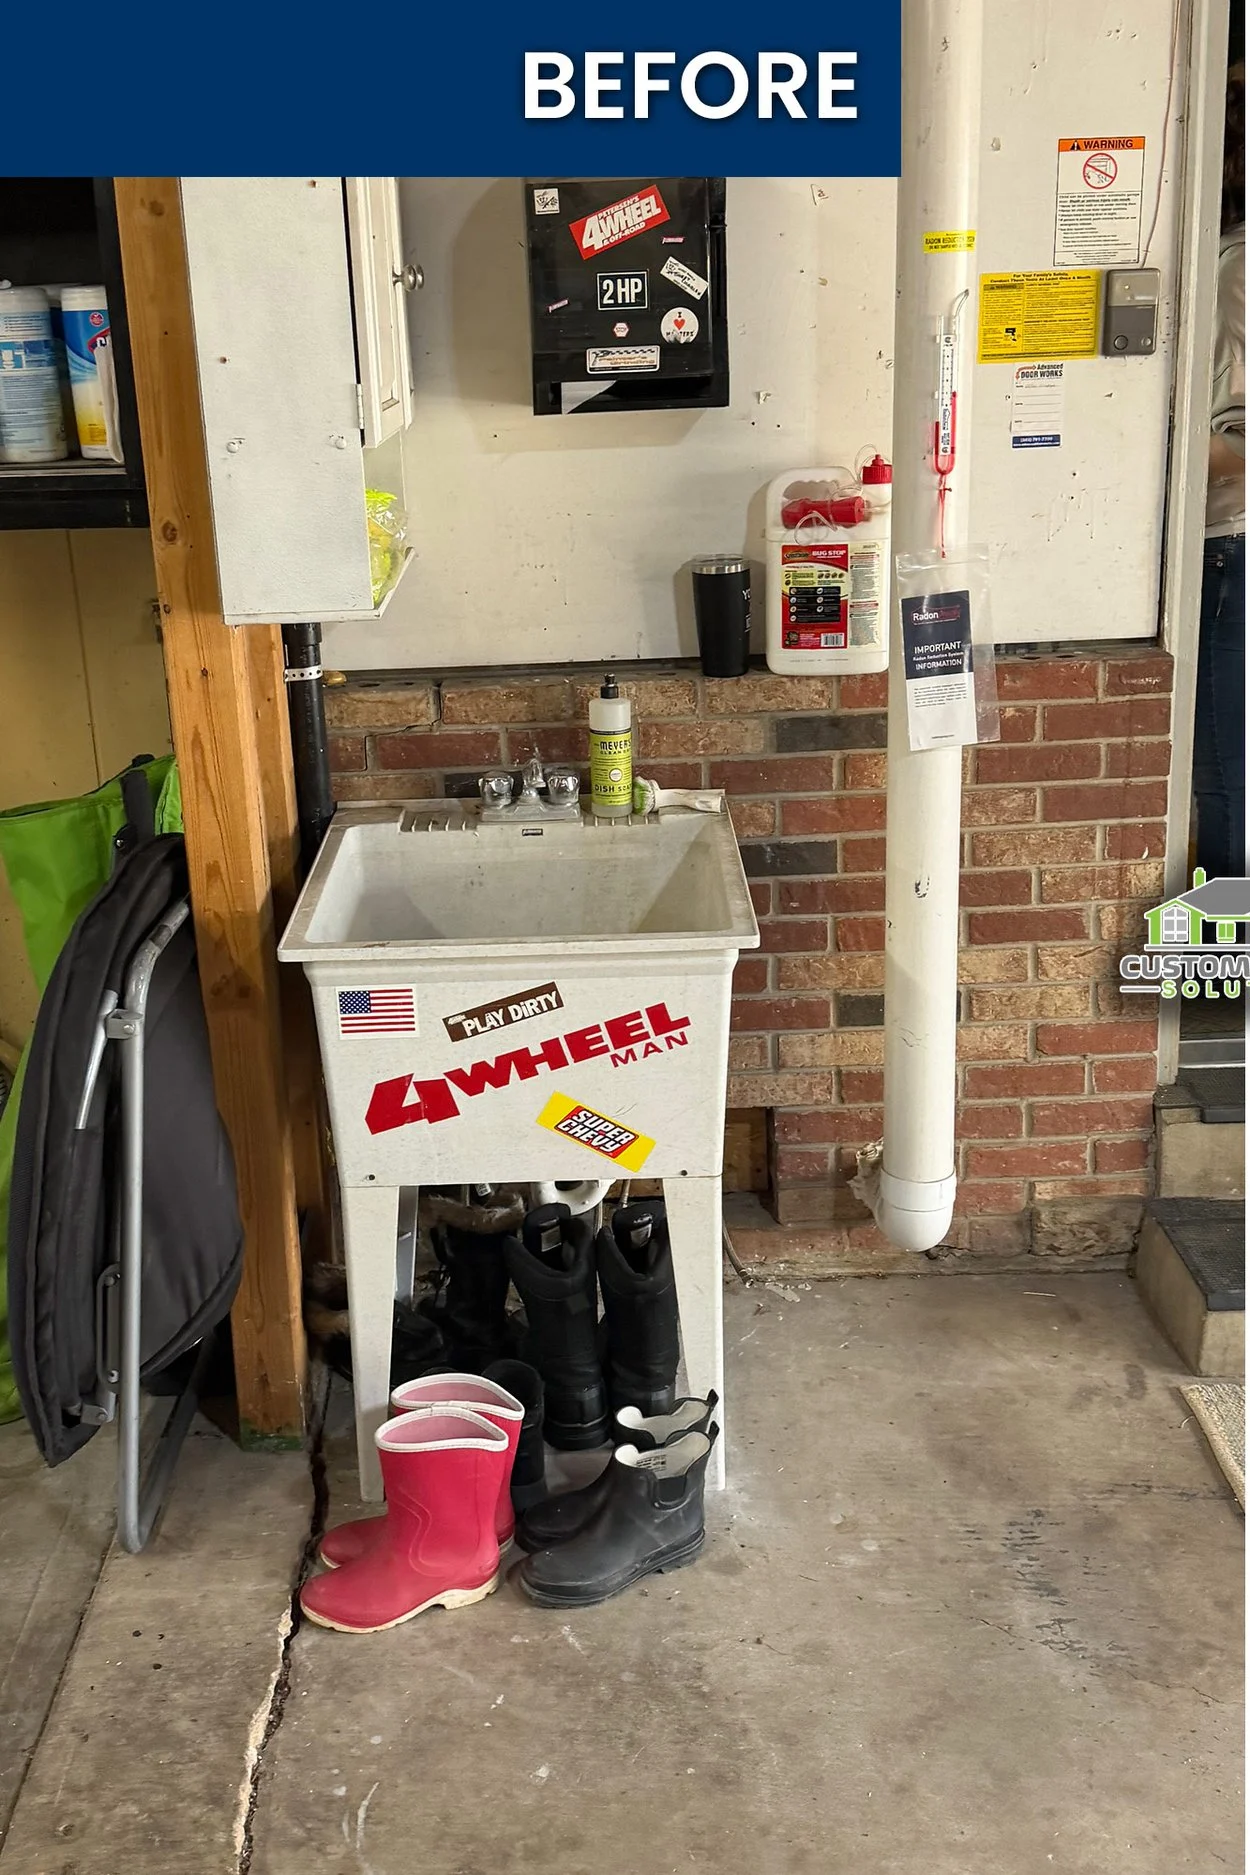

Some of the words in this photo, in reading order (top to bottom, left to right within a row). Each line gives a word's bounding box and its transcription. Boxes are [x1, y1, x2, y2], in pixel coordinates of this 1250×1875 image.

[1083, 139, 1133, 149] WARNING
[582, 194, 662, 251] 4WHEEL
[602, 279, 615, 304] 2
[616, 278, 643, 303] HP
[1040, 369, 1063, 378] WORKS
[914, 641, 961, 654] IMPORTANT
[915, 658, 962, 670] INFORMATION
[594, 784, 614, 792] DISH
[462, 1008, 505, 1037] PLAY
[610, 1031, 690, 1068] MAN
[557, 1119, 622, 1152] CHEVY
[572, 1109, 636, 1145] SUPER
